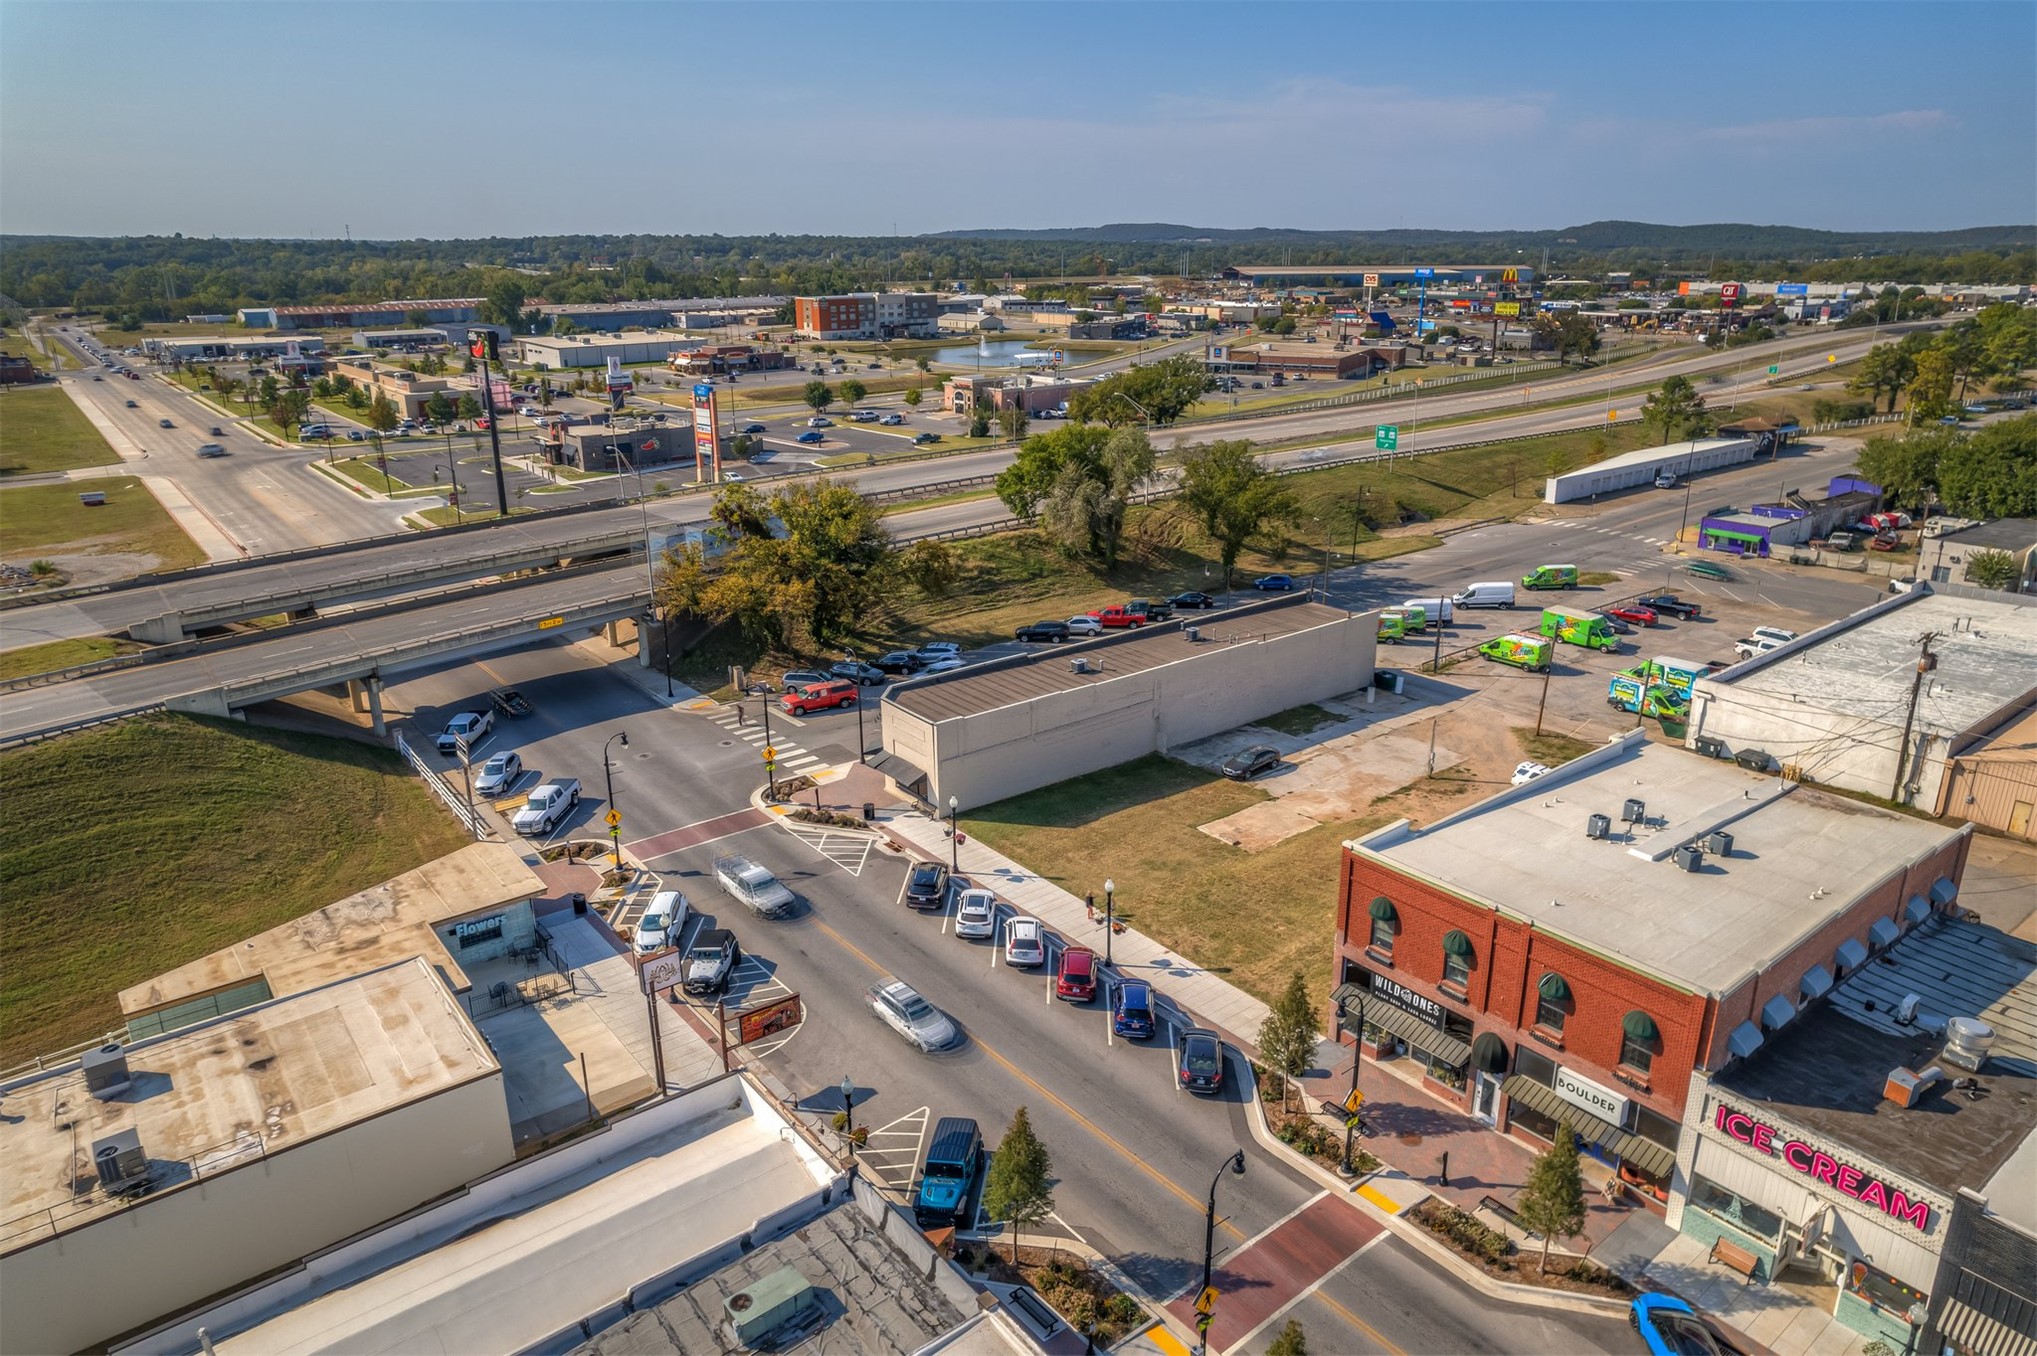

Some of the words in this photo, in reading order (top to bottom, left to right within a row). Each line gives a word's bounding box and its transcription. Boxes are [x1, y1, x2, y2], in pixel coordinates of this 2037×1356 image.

[1723, 286, 1736, 296] QT
[455, 914, 507, 938] Flowers
[1374, 974, 1401, 997] WILD
[1412, 994, 1440, 1016] ONES
[1558, 1077, 1616, 1114] BOULDER
[1715, 1104, 1777, 1156] ICE
[1783, 1140, 1931, 1232] CREAM
